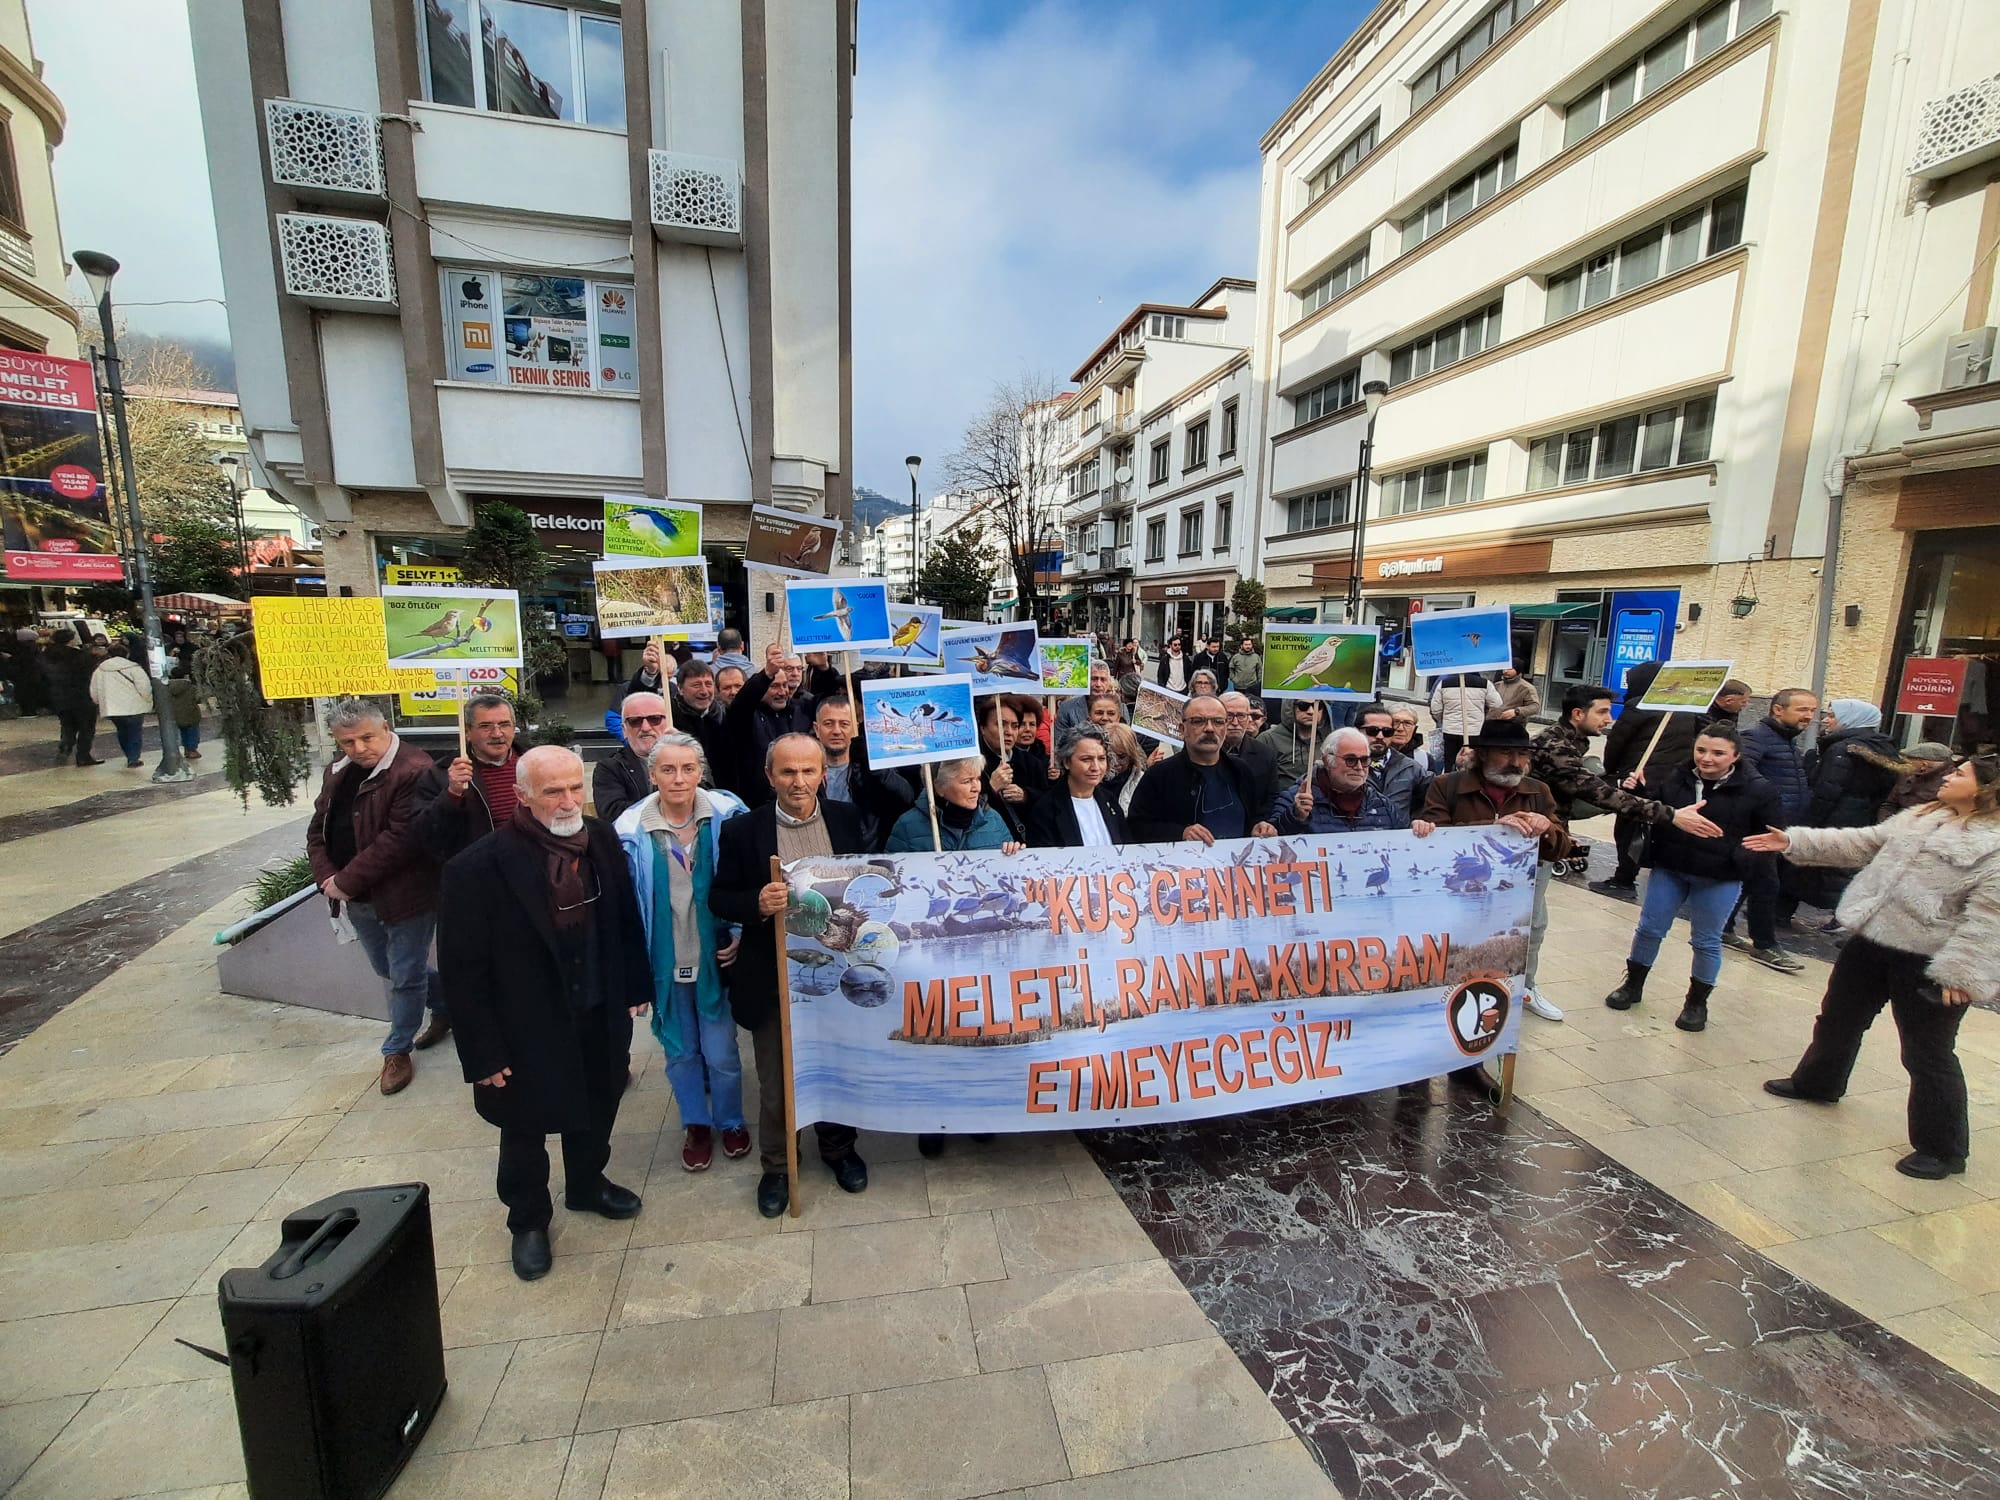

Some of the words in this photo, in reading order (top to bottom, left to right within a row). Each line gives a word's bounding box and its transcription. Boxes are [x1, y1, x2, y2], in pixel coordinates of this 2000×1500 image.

[460, 300, 489, 310] iPhone
[0, 371, 69, 390] MELET
[508, 365, 550, 385] TEKNİK
[552, 368, 591, 388] SERVİS
[618, 371, 631, 380] LG
[527, 513, 604, 531] Telekom
[397, 570, 436, 579] SELYF
[303, 598, 374, 612] HERKES
[260, 610, 323, 626] ÖNCEDEN
[259, 626, 277, 640] BU
[280, 626, 325, 639] KANUN
[316, 640, 336, 653] VE
[1617, 645, 1653, 660] PARA
[264, 666, 328, 681] TOPLANTI
[436, 672, 452, 680] GB
[469, 669, 498, 679] 620
[265, 681, 337, 698] DÜZENLEME
[338, 680, 380, 693] HAKKINA
[1907, 683, 1955, 693] İNDİRİMİ
[1025, 871, 1140, 943] "KUŞ
[1150, 846, 1333, 926] CENNETİ
[903, 947, 1107, 1034] MELET'İ,
[1116, 946, 1262, 1018] RANTA
[1267, 932, 1450, 999] KURBAN
[1026, 1009, 1352, 1114] ETMEYECEĞİZ"
